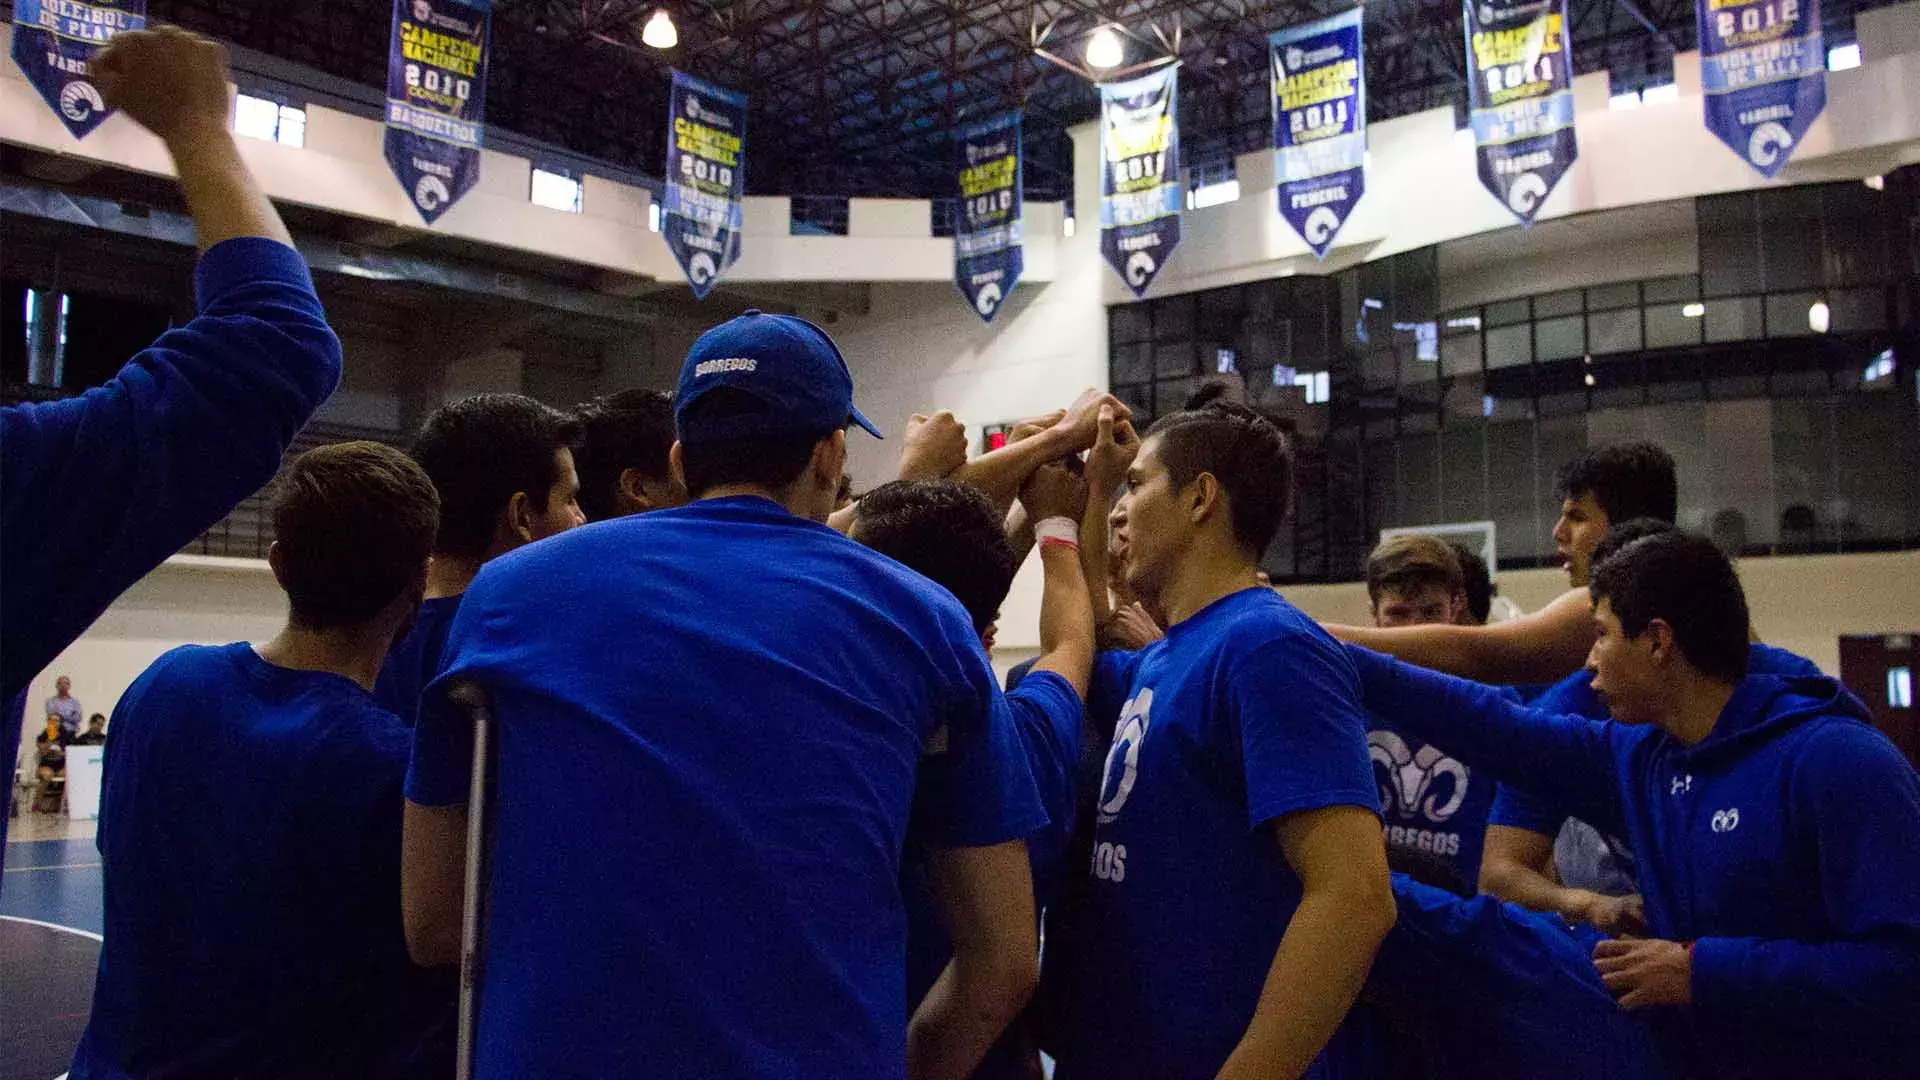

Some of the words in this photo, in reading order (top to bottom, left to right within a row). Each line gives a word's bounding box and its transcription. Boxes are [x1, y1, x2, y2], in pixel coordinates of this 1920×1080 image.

[68, 20, 116, 40] PLAY
[1717, 0, 1800, 37] 2012
[405, 64, 470, 100] 2010
[1487, 56, 1553, 93] 2011
[1290, 100, 1348, 134] 2011
[681, 154, 732, 187] 2010
[1115, 153, 1165, 184] 2011
[967, 190, 1011, 219] 2010
[695, 358, 757, 377] BORREGOS
